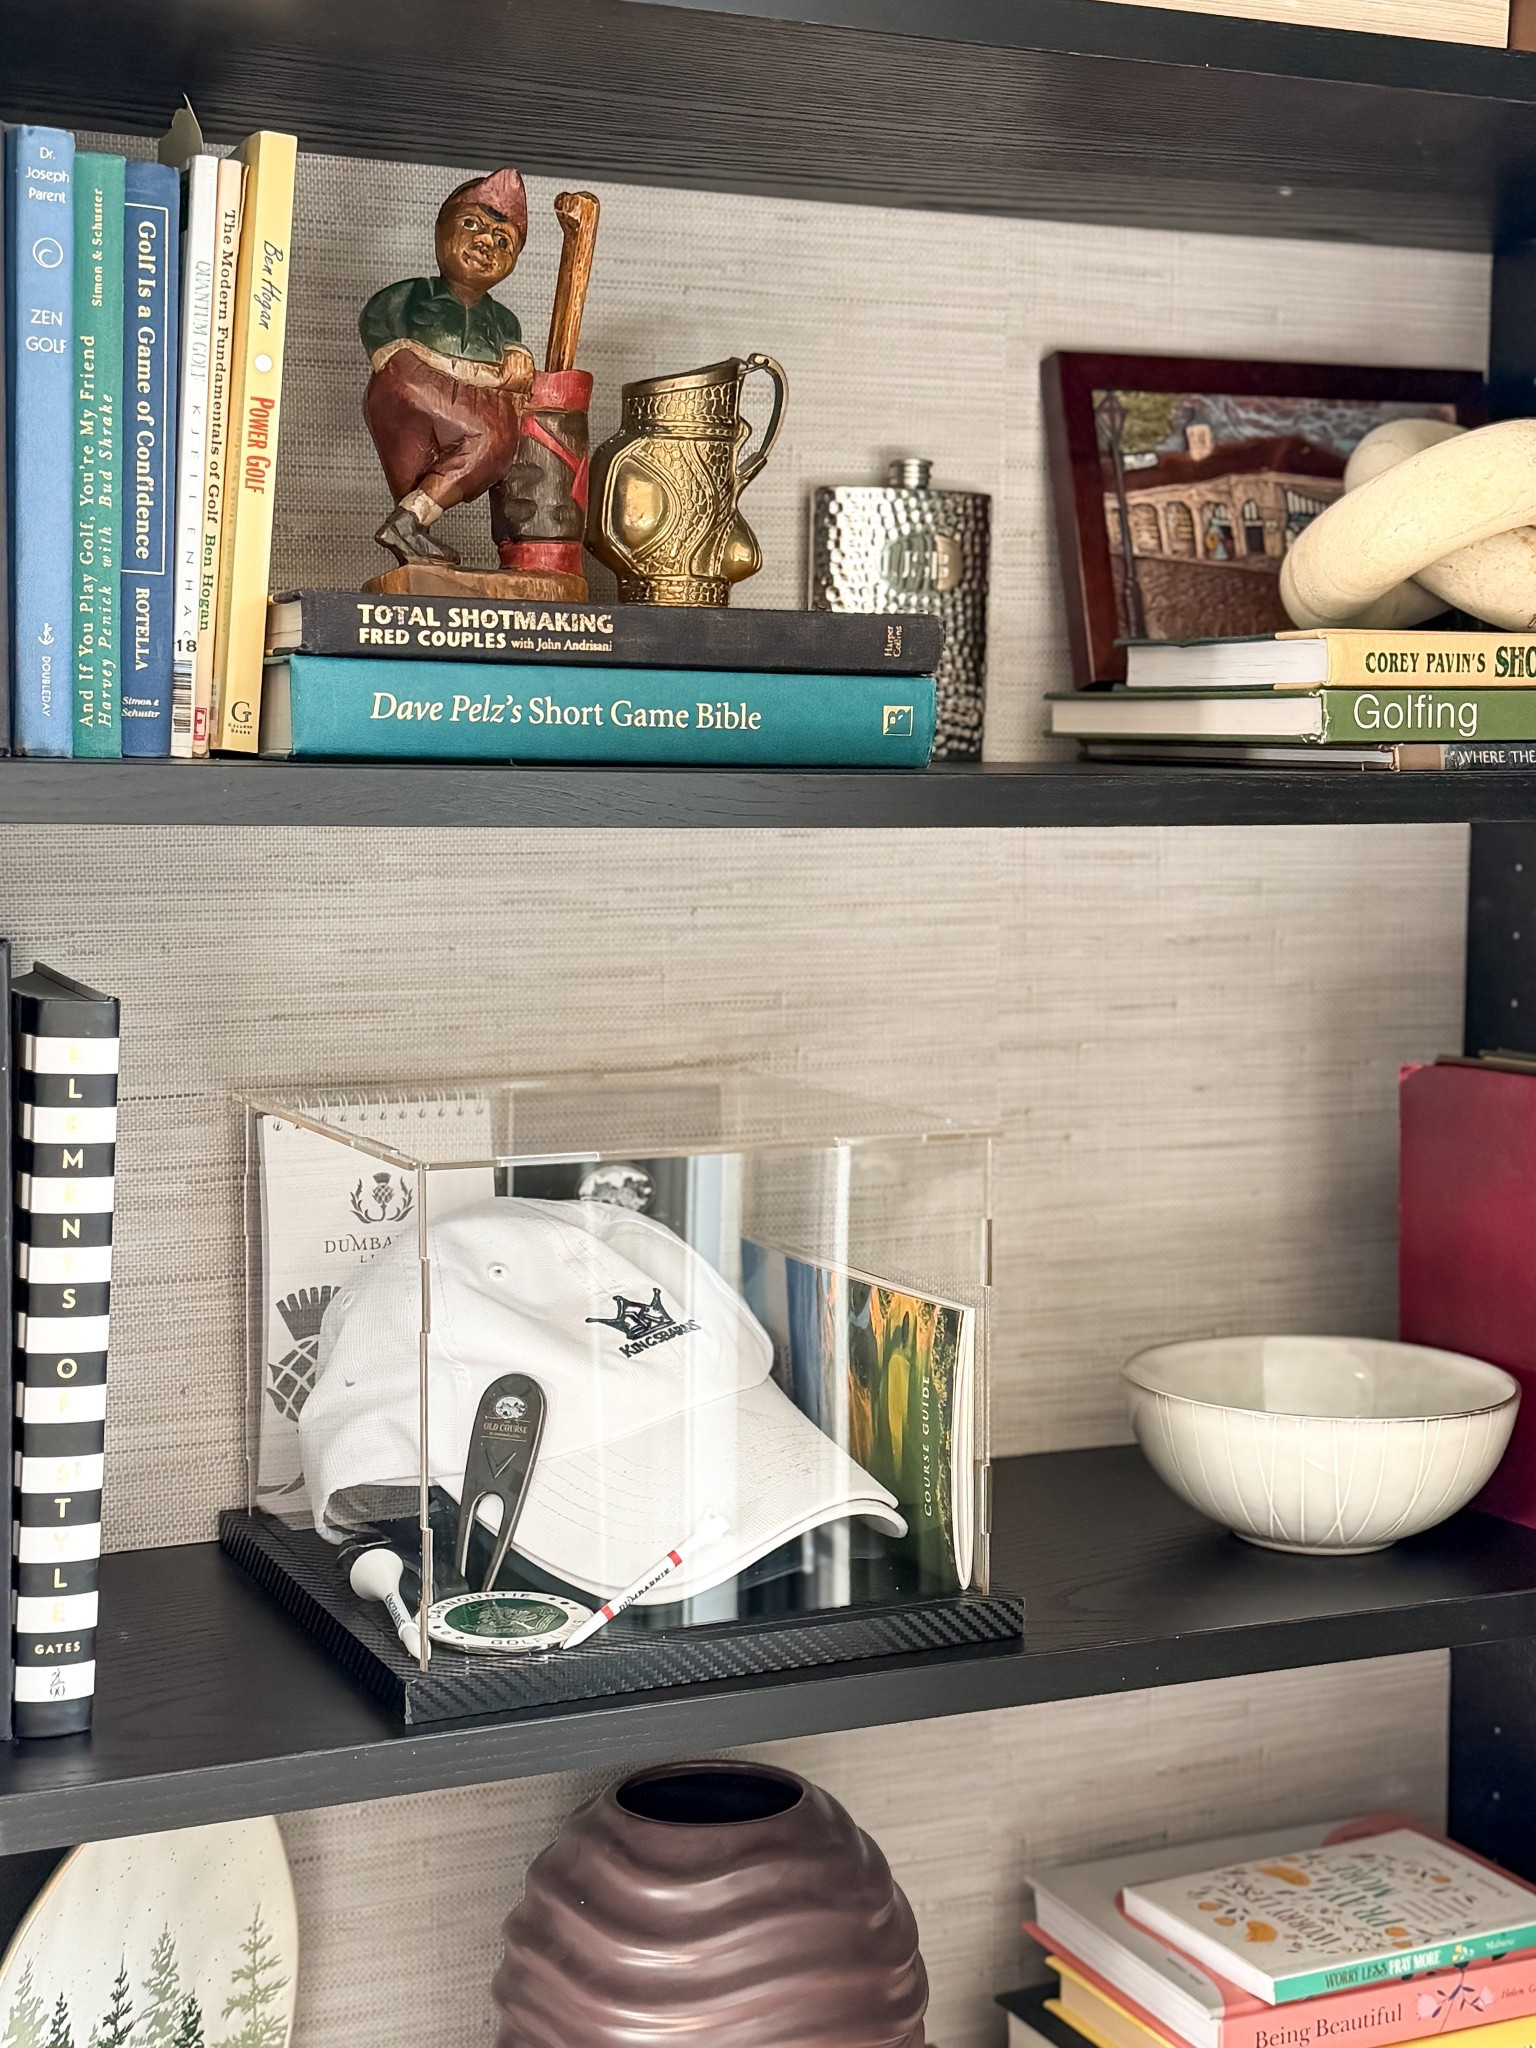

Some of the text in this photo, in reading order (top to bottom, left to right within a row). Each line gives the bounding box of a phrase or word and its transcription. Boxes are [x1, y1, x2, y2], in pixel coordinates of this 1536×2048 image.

[39, 146, 56, 160] Dr.
[25, 166, 70, 184] Joseph
[28, 186, 66, 203] Parent
[91, 188, 103, 308] Simon & Schuster
[193, 260, 211, 336] QUANTUM
[254, 240, 284, 330] Ben Hogan
[30, 309, 63, 326] ZEN
[25, 336, 67, 353] GOLF
[190, 342, 207, 382] GOLF
[136, 221, 157, 559] Golf Is a Game of Confidence
[199, 209, 236, 631] The Modern Fundamentals of Golf Ben Hogan
[245, 395, 275, 494] POWER GOLF
[79, 335, 98, 728] And If You Play Golf, You're My Friend
[98, 393, 116, 728] Harvey Penick with Bud Shrake
[135, 587, 150, 671] ROTELLA
[357, 603, 614, 634] TOTAL SHOTMAKING
[175, 639, 197, 652] 18
[359, 627, 613, 652] FRED COUPLES with John Andrisani
[884, 625, 894, 658] Harper
[1365, 652, 1420, 673] COREY
[1426, 652, 1486, 673] PAVIN'S
[41, 656, 51, 717] DOUBLEDAY
[122, 696, 151, 707] Simon
[369, 692, 762, 731] Dave Pelz's Short Game Bible
[1354, 693, 1478, 737] Golfing
[1459, 750, 1536, 765] WHERE THE
[324, 1233, 399, 1254] DUMBA
[483, 1422, 528, 1434] OLD COURSE
[922, 1375, 932, 1517] COURSE GUIDE
[34, 1641, 81, 1655] GATES
[1325, 1966, 1360, 1988] WORRY
[1361, 1963, 1388, 1981] LESS
[1413, 1950, 1442, 1970] MORE
[1256, 2024, 1311, 2048] Being
[1316, 2004, 1402, 2037] Beautiful
[1501, 1987, 1525, 1999] Helen
